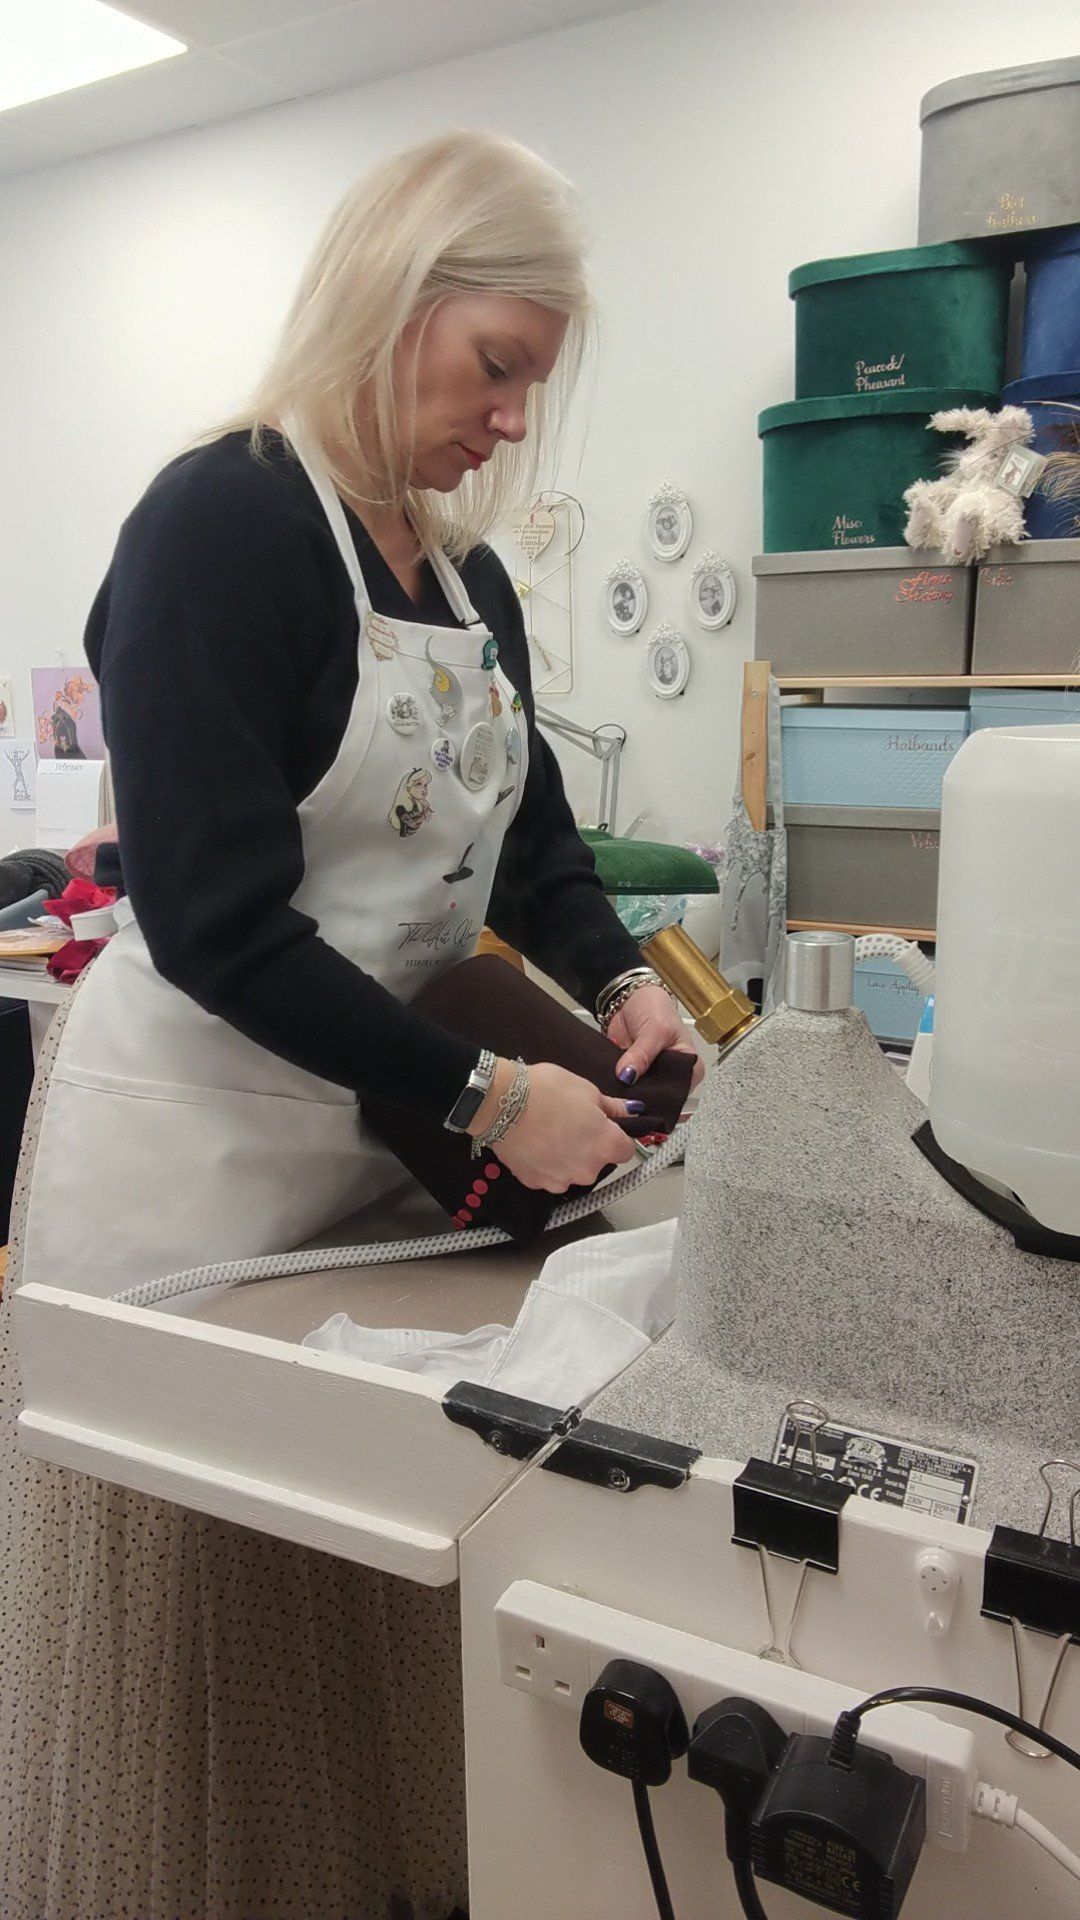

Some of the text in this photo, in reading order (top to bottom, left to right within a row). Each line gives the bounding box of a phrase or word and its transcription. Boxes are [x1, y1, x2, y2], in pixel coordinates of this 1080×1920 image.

[855, 374, 905, 392] Pheasant
[832, 530, 876, 546] Flowers
[881, 734, 955, 752] Hatbands
